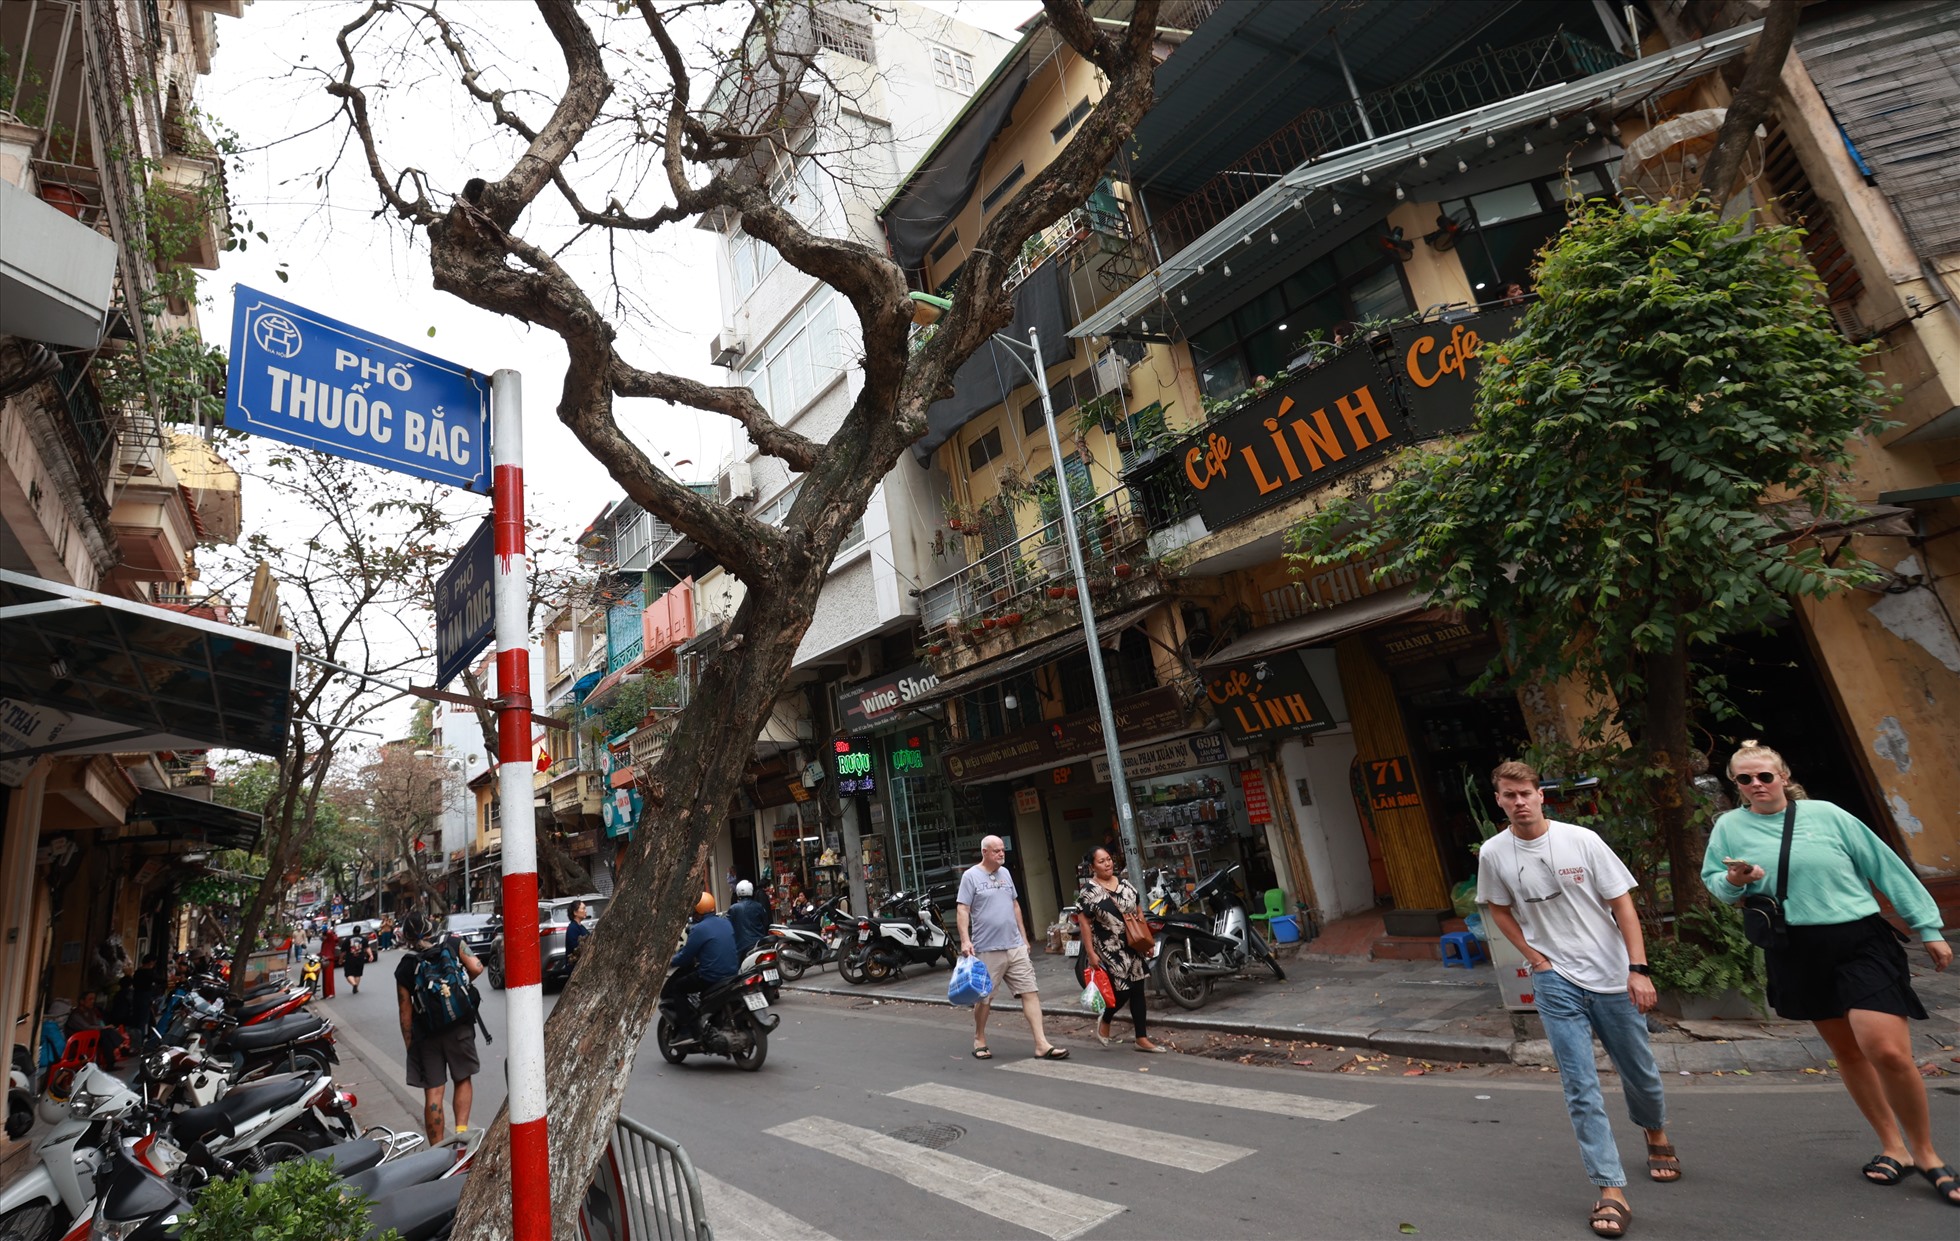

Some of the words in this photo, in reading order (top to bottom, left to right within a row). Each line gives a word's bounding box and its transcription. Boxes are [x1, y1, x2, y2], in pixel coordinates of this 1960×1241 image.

[335, 348, 413, 392] PHỐ
[1406, 323, 1479, 389] Cafe
[267, 366, 393, 444] THUỐC
[404, 405, 470, 467] BẮC
[1185, 432, 1231, 490] Cafe
[1239, 395, 1393, 496] LÍNH
[454, 551, 474, 601] PHỐ
[465, 580, 492, 640] ÔNG
[1384, 633, 1434, 653] THANH
[862, 689, 897, 714] wine
[1207, 668, 1251, 704] Cafe
[1232, 683, 1313, 734] LÍNH
[1196, 736, 1220, 750] 69B
[1371, 759, 1404, 785] 71
[1397, 791, 1420, 807] ÔNG
